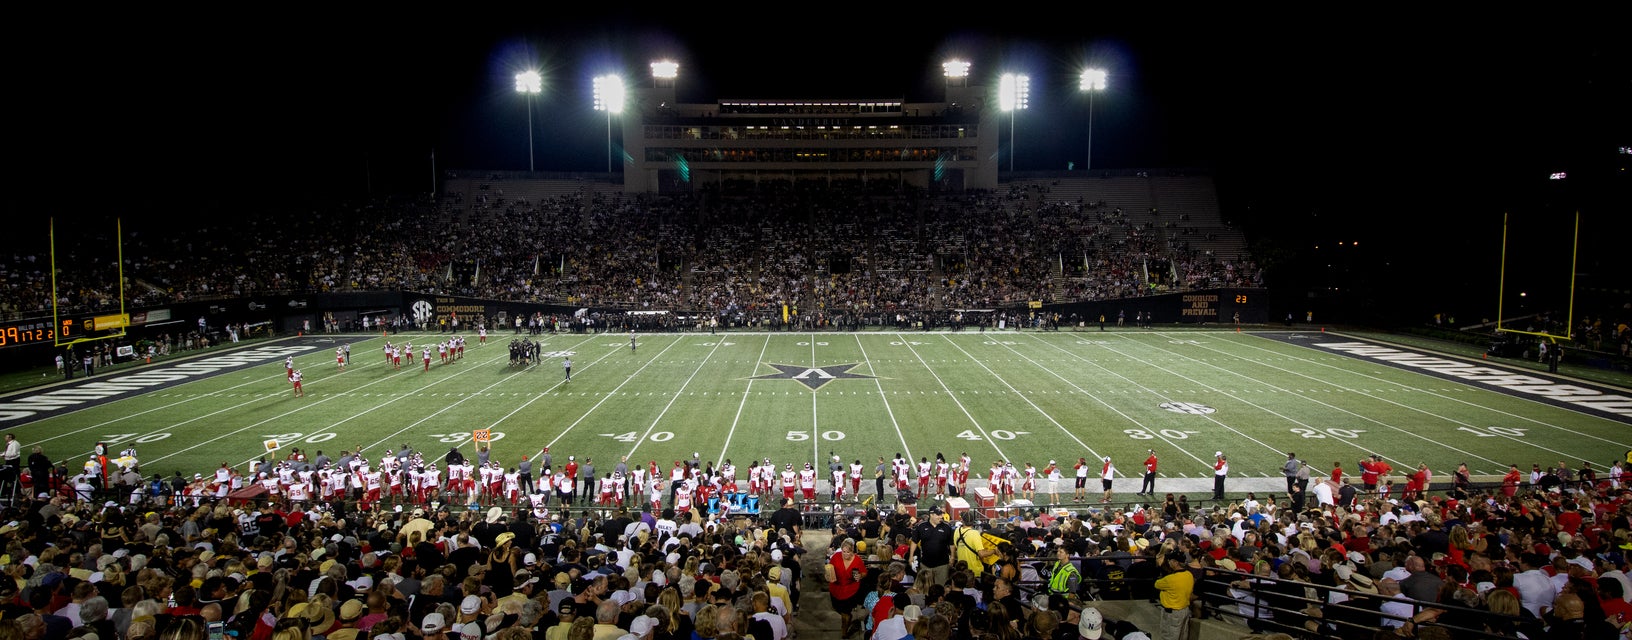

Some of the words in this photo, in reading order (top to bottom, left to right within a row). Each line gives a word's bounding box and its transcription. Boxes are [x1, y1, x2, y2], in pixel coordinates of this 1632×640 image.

[772, 118, 850, 126] VANDERBILT
[1235, 295, 1247, 304] 23
[411, 300, 433, 322] SEC
[436, 305, 485, 313] COMMODORE
[22, 330, 33, 342] 17
[36, 329, 43, 341] 2
[47, 329, 54, 339] 2
[63, 325, 70, 336] 0
[613, 430, 675, 442] 40
[785, 430, 846, 441] 50
[956, 429, 1016, 441] 40
[1123, 429, 1189, 440] 30
[1290, 427, 1359, 439] 20
[1456, 426, 1525, 437] 10
